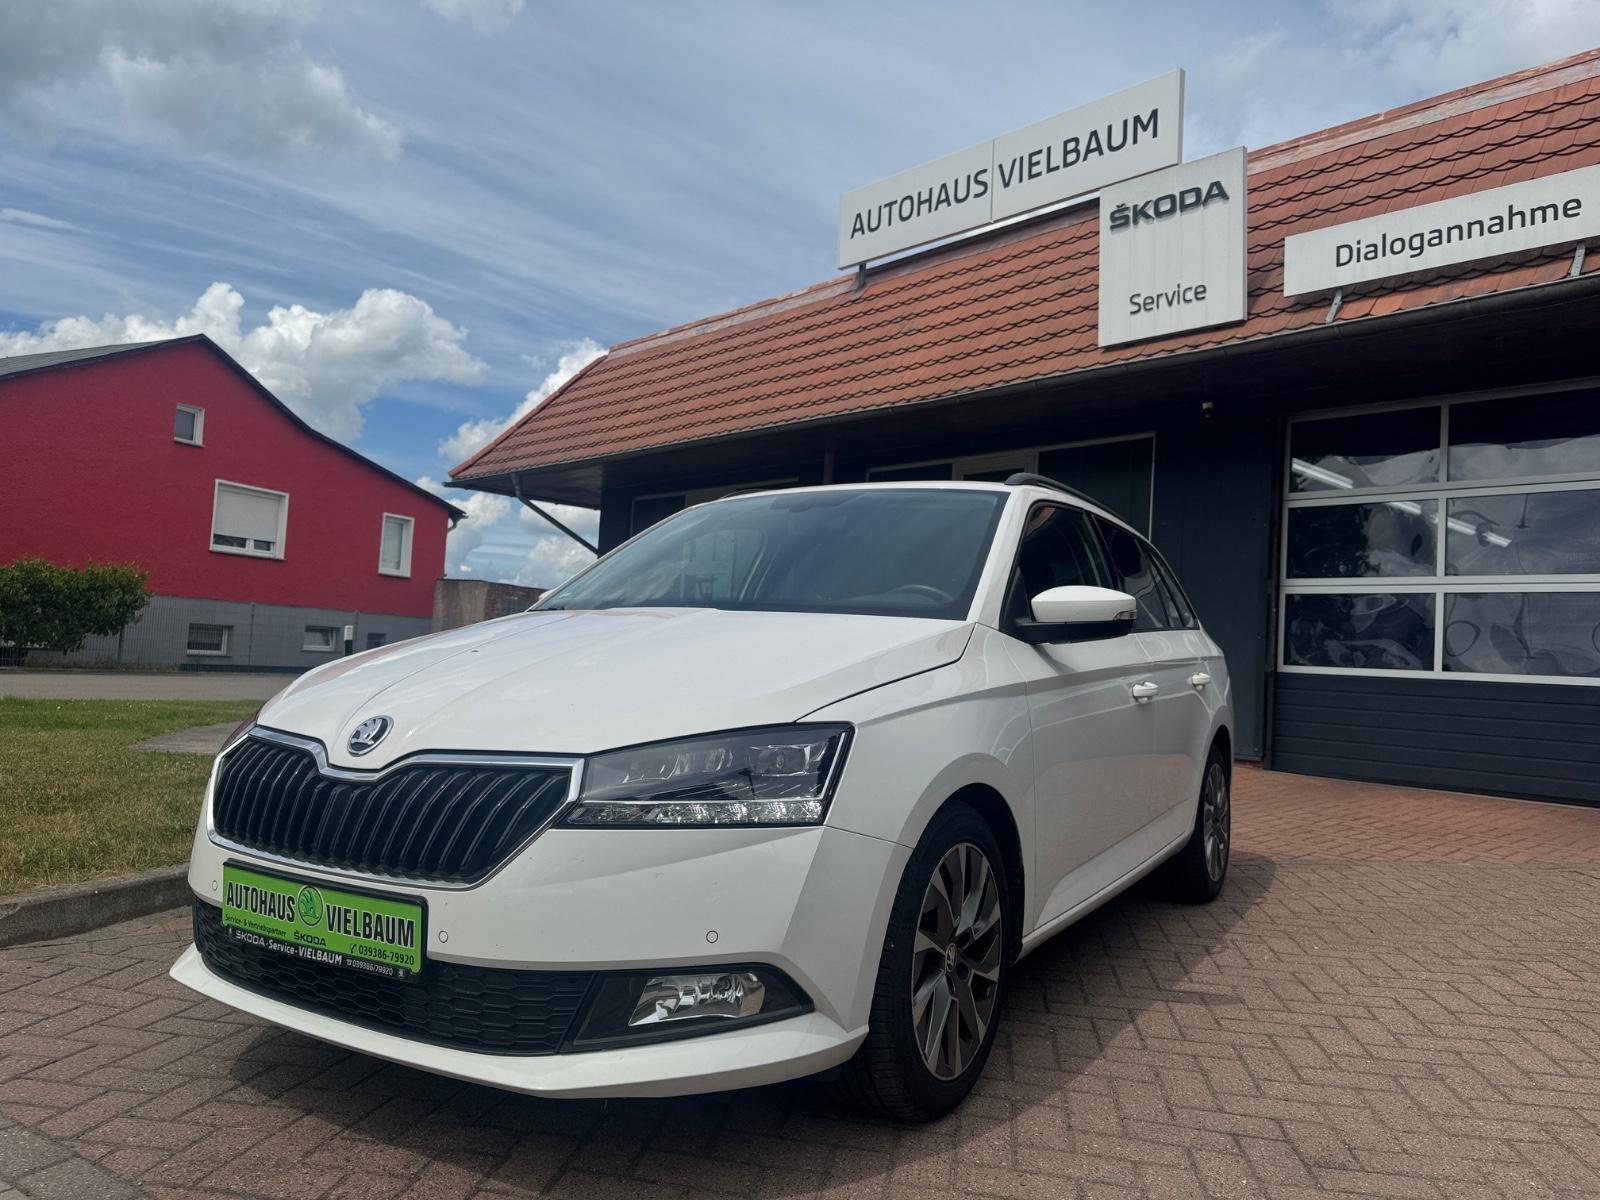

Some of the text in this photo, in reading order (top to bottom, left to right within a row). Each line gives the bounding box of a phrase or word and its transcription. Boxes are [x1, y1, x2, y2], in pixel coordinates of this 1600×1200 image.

[850, 108, 1159, 239] AUTOHAUS VIELBAUM
[1110, 180, 1230, 231] ŠKODA
[1335, 198, 1582, 268] Dialogannahme
[1129, 283, 1207, 315] Service
[226, 882, 415, 948] AUTOHAUS VIELBAUM
[294, 930, 327, 947] ŠKODA
[358, 945, 415, 965] 039386-79920
